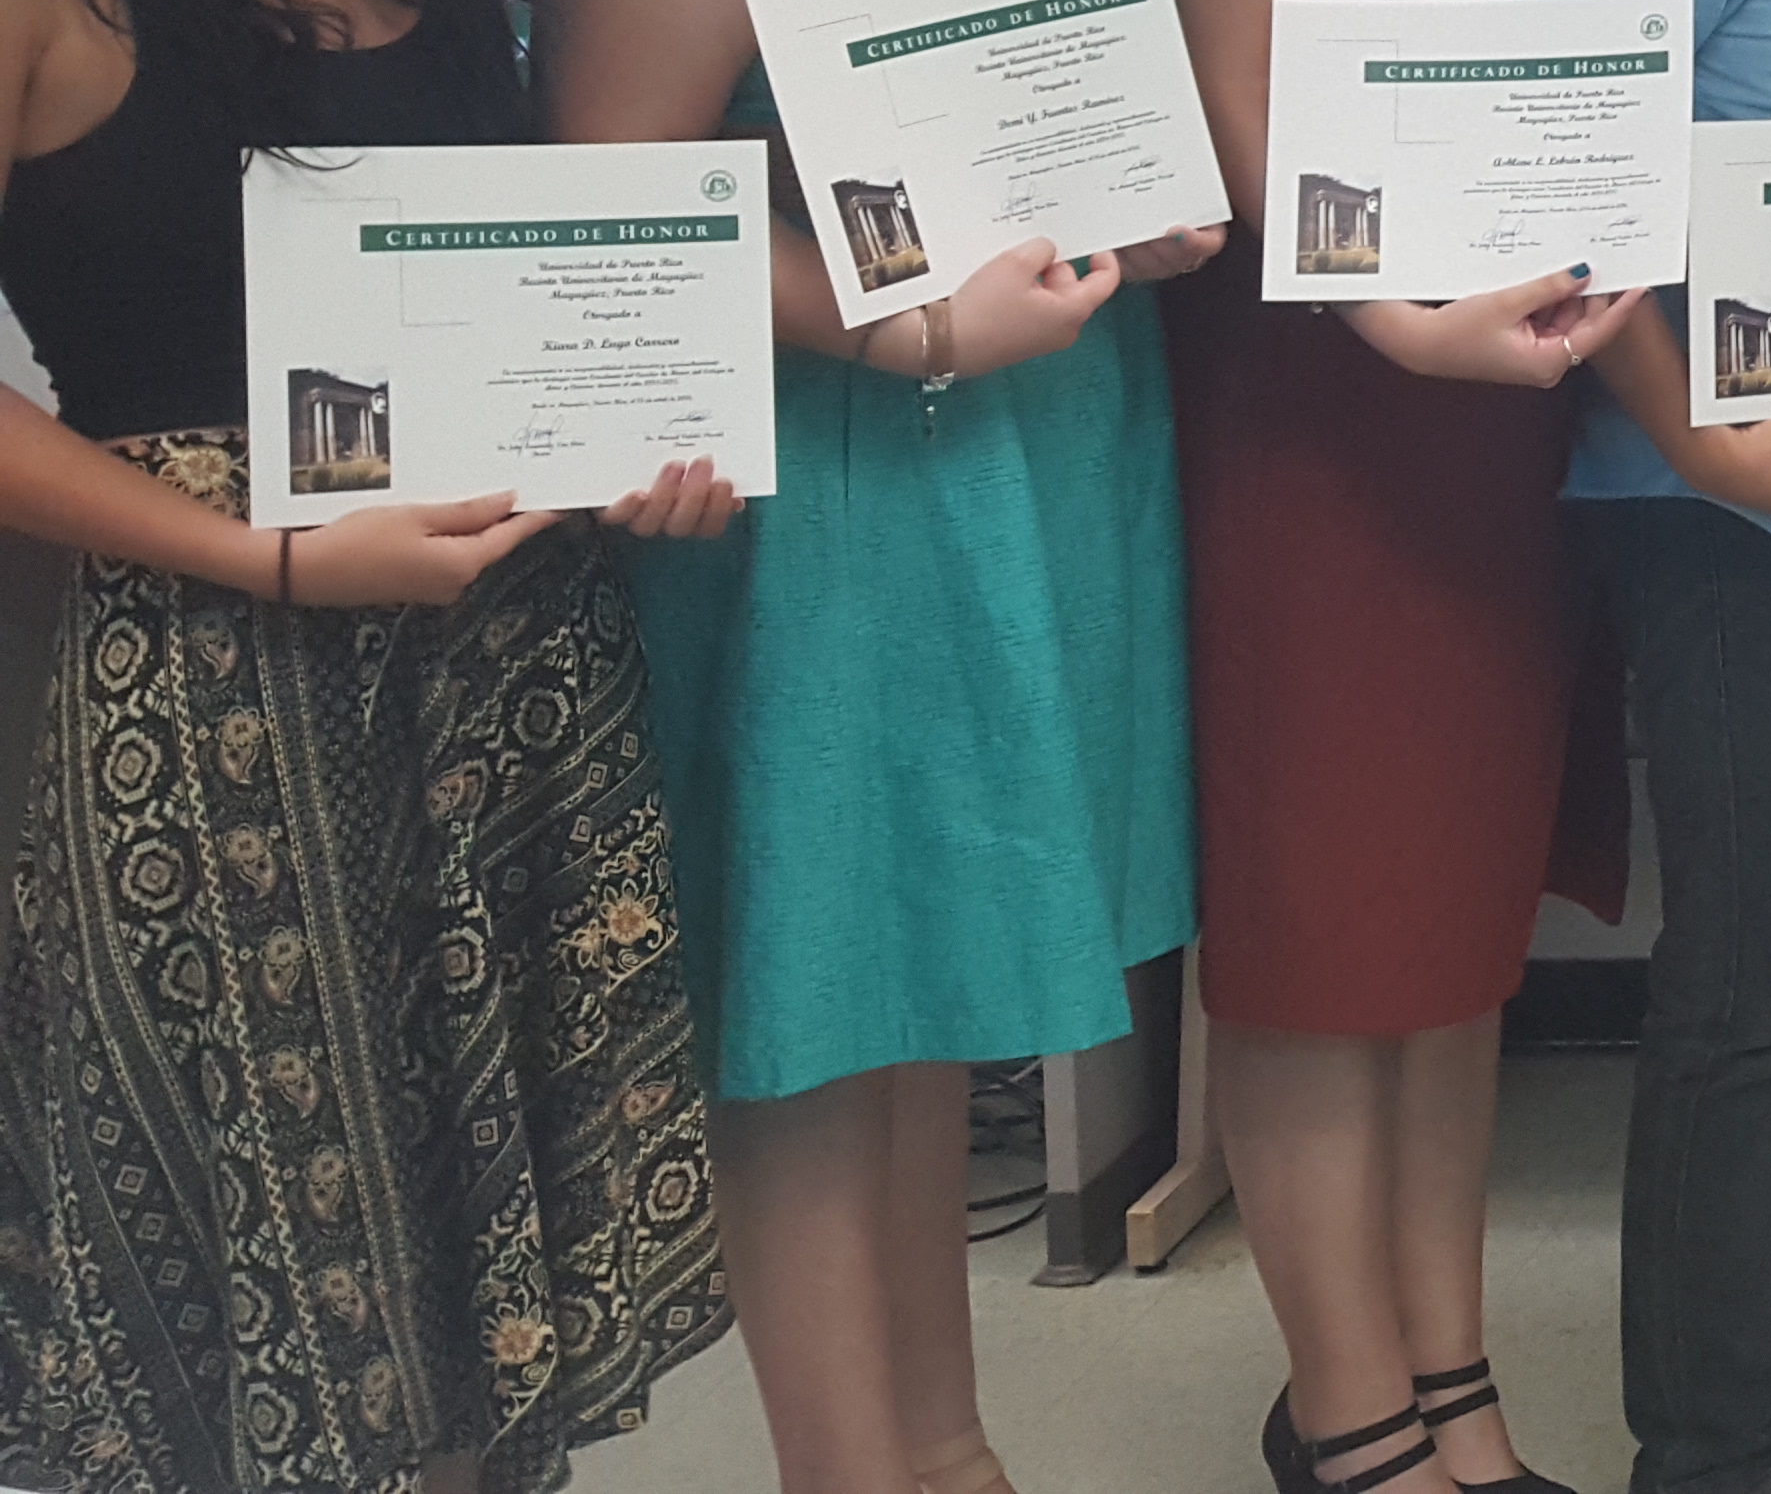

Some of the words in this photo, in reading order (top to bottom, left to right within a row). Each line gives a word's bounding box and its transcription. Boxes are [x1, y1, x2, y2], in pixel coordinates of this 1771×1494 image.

[866, 18, 997, 58] CERTIFICADO
[1009, 9, 1033, 25] DE
[1384, 65, 1525, 79] CERTIFICADO
[1537, 64, 1560, 75] DE
[1573, 59, 1645, 74] HONOR
[385, 229, 557, 246] CERTIFICADO
[573, 227, 602, 241] DE
[618, 223, 708, 239] HONOR
[538, 260, 603, 271] Universidad
[605, 259, 618, 269] de
[620, 258, 656, 268] Puerto
[658, 257, 683, 267] Rico
[630, 272, 643, 282] de
[612, 287, 648, 297] Puerto
[650, 286, 675, 296] Rico
[540, 340, 578, 352] Kiara
[599, 337, 631, 351] Lugo
[634, 336, 680, 347] Carrero
